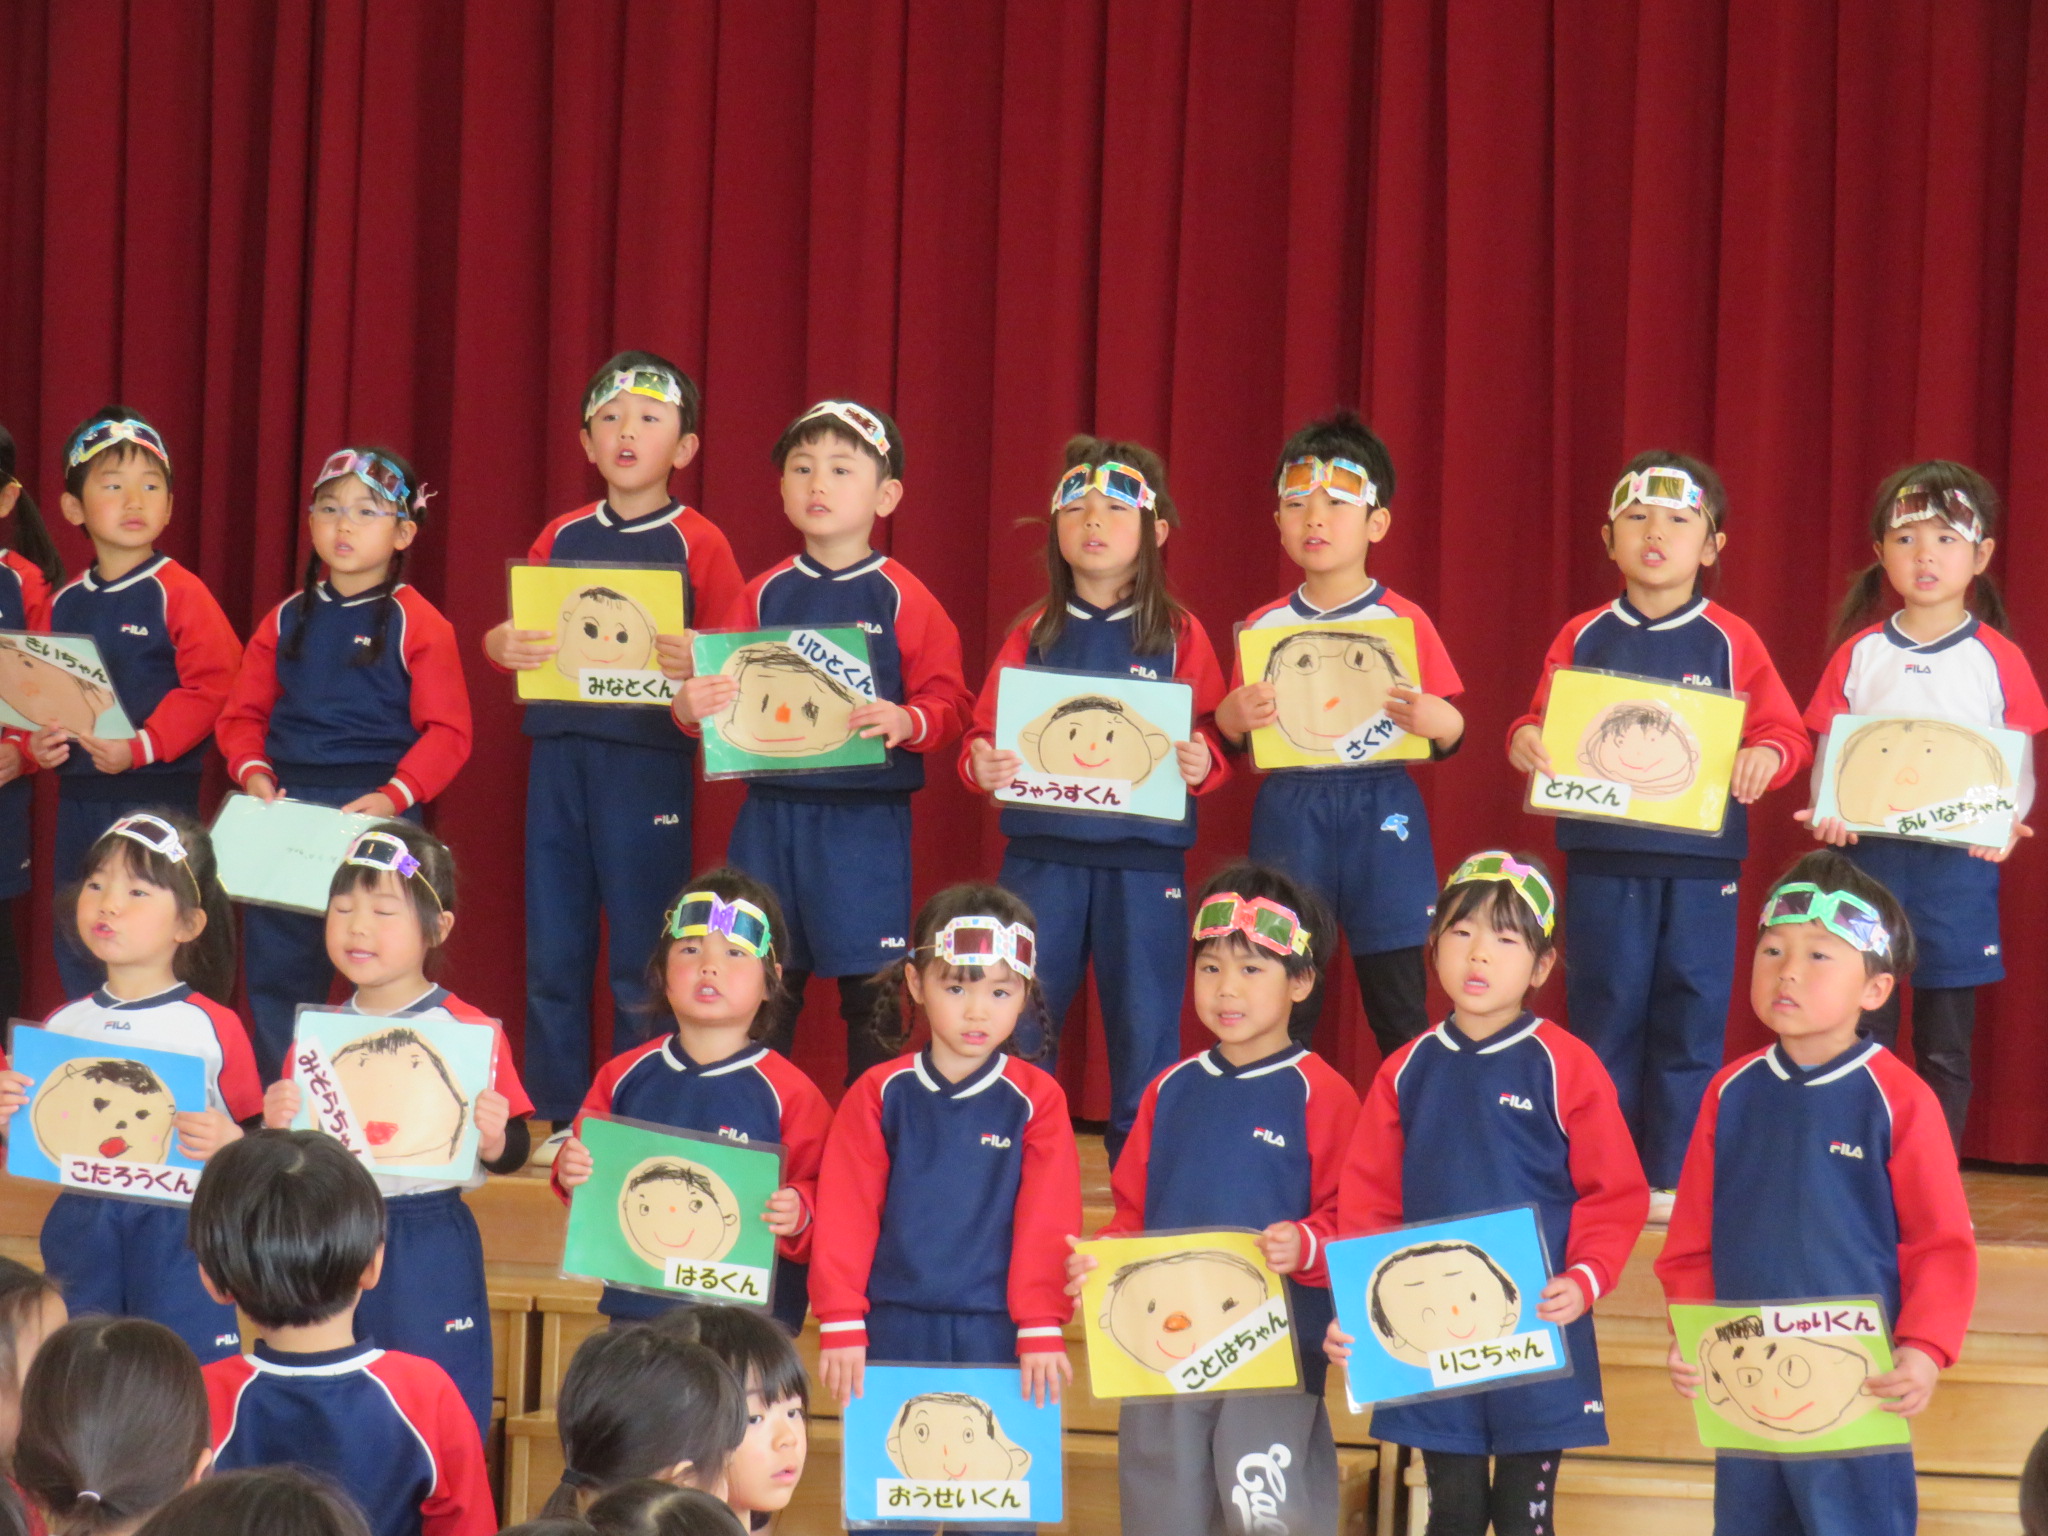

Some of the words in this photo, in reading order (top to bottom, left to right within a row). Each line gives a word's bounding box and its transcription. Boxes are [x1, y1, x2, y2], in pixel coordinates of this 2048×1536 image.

[121, 623, 149, 636] FILA
[857, 620, 883, 634] FILA
[25, 636, 108, 684] きいちゃん
[797, 633, 873, 696] りひとくん
[1904, 664, 1932, 675] FILA
[1130, 664, 1158, 680] FILA
[1682, 673, 1713, 687] FILA
[588, 676, 674, 699] みなとくん
[1010, 778, 1121, 806] ちゃうすくん
[1545, 779, 1621, 807] とわくん
[654, 813, 680, 825] FILA
[1896, 795, 2013, 834] あいなちゃん
[880, 937, 906, 948] FILA
[103, 1020, 132, 1031] FILA
[1499, 1092, 1534, 1111] FILA
[718, 1125, 750, 1145] FILA
[981, 1132, 1012, 1149] FILA
[1253, 1127, 1286, 1148] FILA
[1829, 1140, 1864, 1160] FILA
[71, 1161, 194, 1195] こたろうくん
[675, 1264, 758, 1296] はるくん
[445, 1316, 475, 1333] FILA
[1774, 1311, 1876, 1333] しゅりくん
[215, 1333, 240, 1347] FILA
[1182, 1312, 1288, 1390] ことはちゃん
[1440, 1337, 1544, 1374] りこちゃん
[889, 1486, 1021, 1508] おうせいくん
